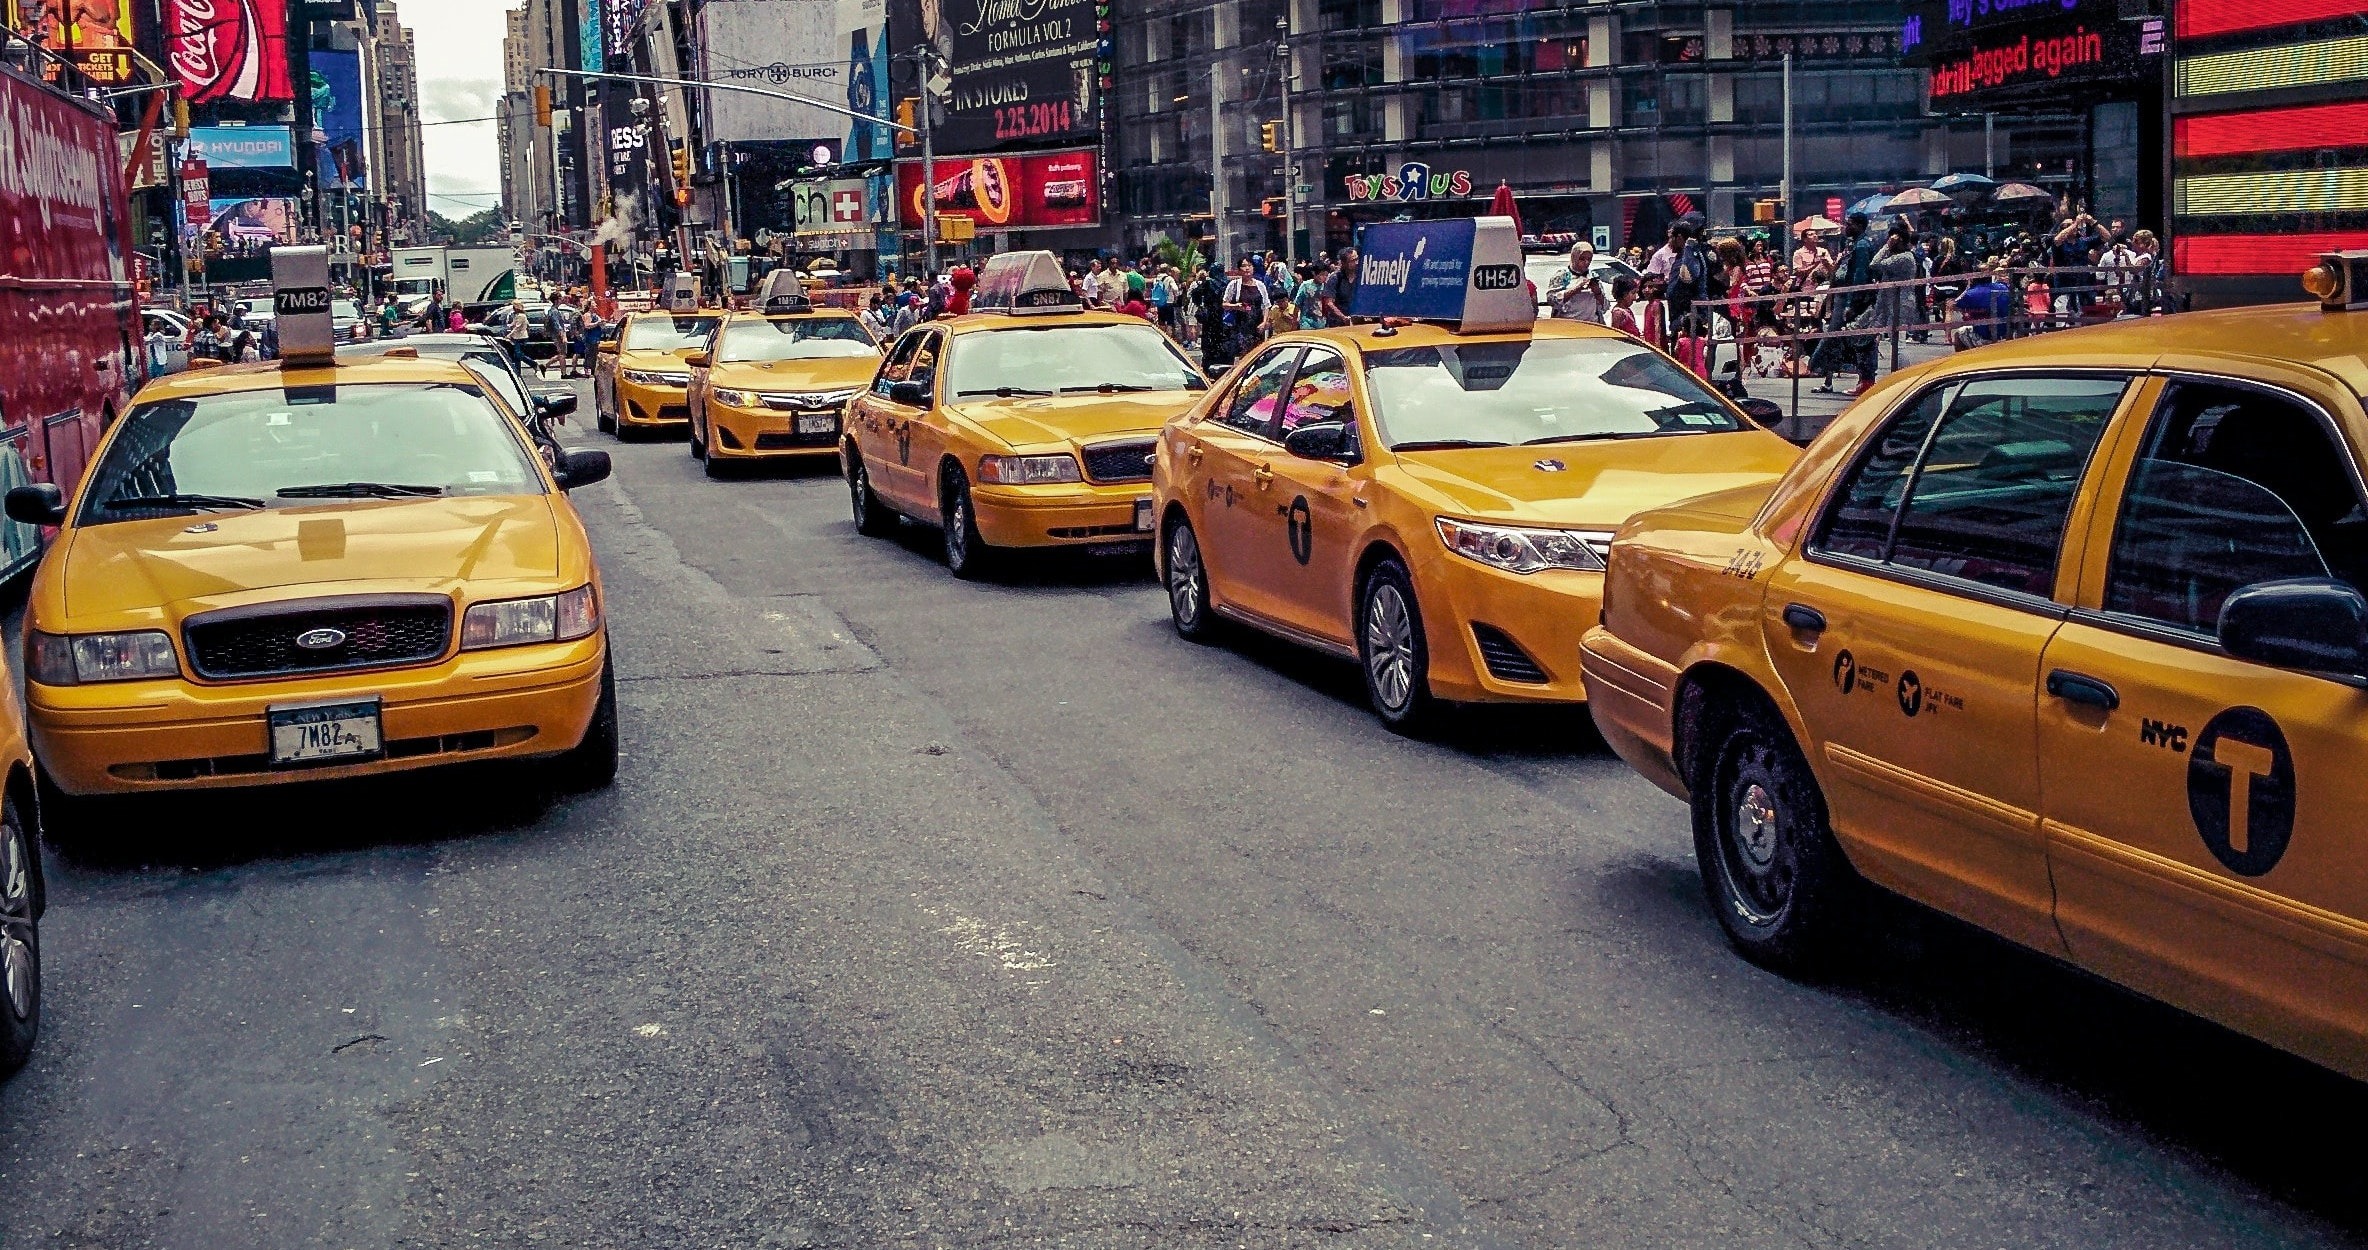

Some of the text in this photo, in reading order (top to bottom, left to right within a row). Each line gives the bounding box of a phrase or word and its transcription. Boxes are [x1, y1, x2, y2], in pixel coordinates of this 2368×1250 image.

[988, 18, 1072, 52] FORMULA VOL 2
[89, 53, 113, 63] GET
[2033, 26, 2102, 77] again
[730, 69, 764, 79] TORY
[956, 79, 1028, 111] IN STORES
[994, 100, 1070, 139] 2.25.2014
[211, 141, 282, 153] HYUNDAI
[1360, 251, 1412, 294] Namely
[1476, 269, 1517, 287] 1H54
[278, 290, 329, 308] 7M82
[308, 633, 333, 645] Ford
[2141, 717, 2188, 753] NYC
[2214, 736, 2274, 853] T
